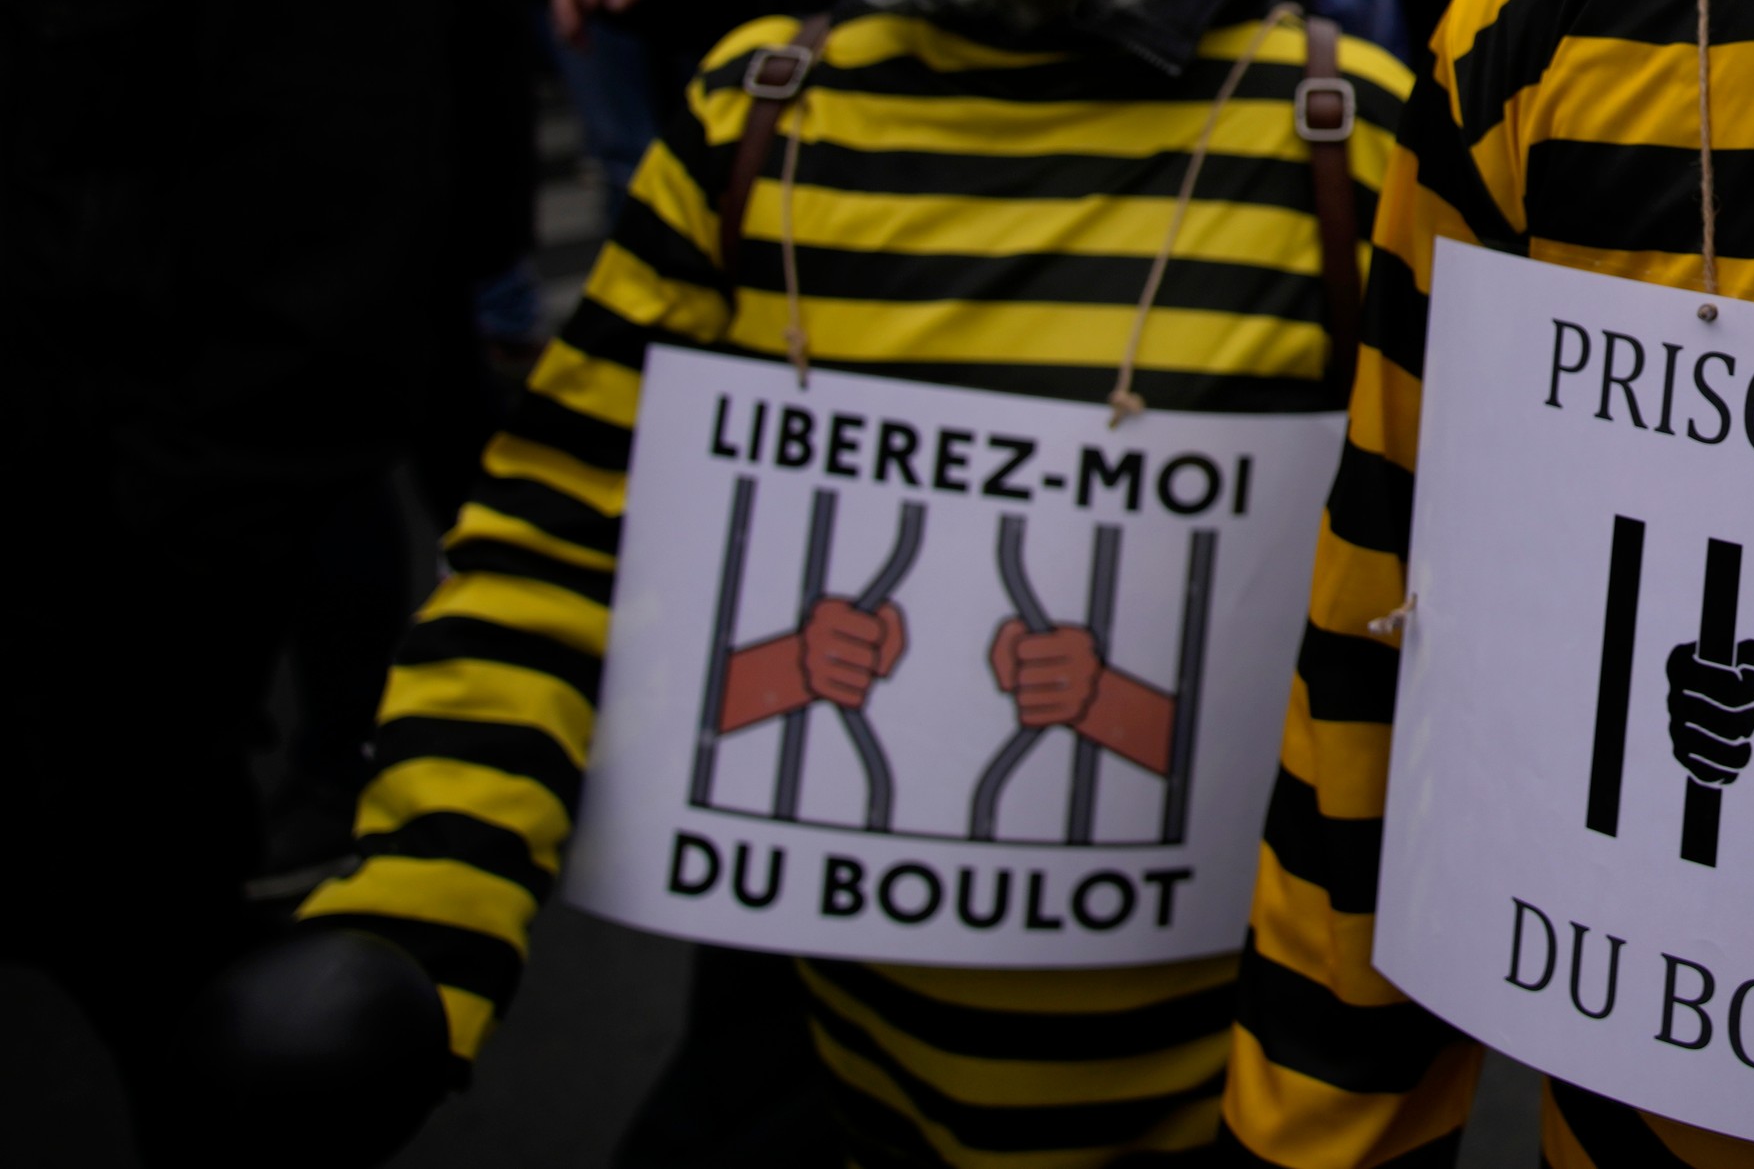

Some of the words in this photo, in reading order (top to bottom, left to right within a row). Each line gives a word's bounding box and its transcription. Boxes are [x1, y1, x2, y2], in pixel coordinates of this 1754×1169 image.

[709, 394, 1254, 517] LIBEREZ-MOI
[668, 832, 786, 909] DU
[820, 855, 1194, 932] BOULOT
[1503, 896, 1627, 1021] DU
